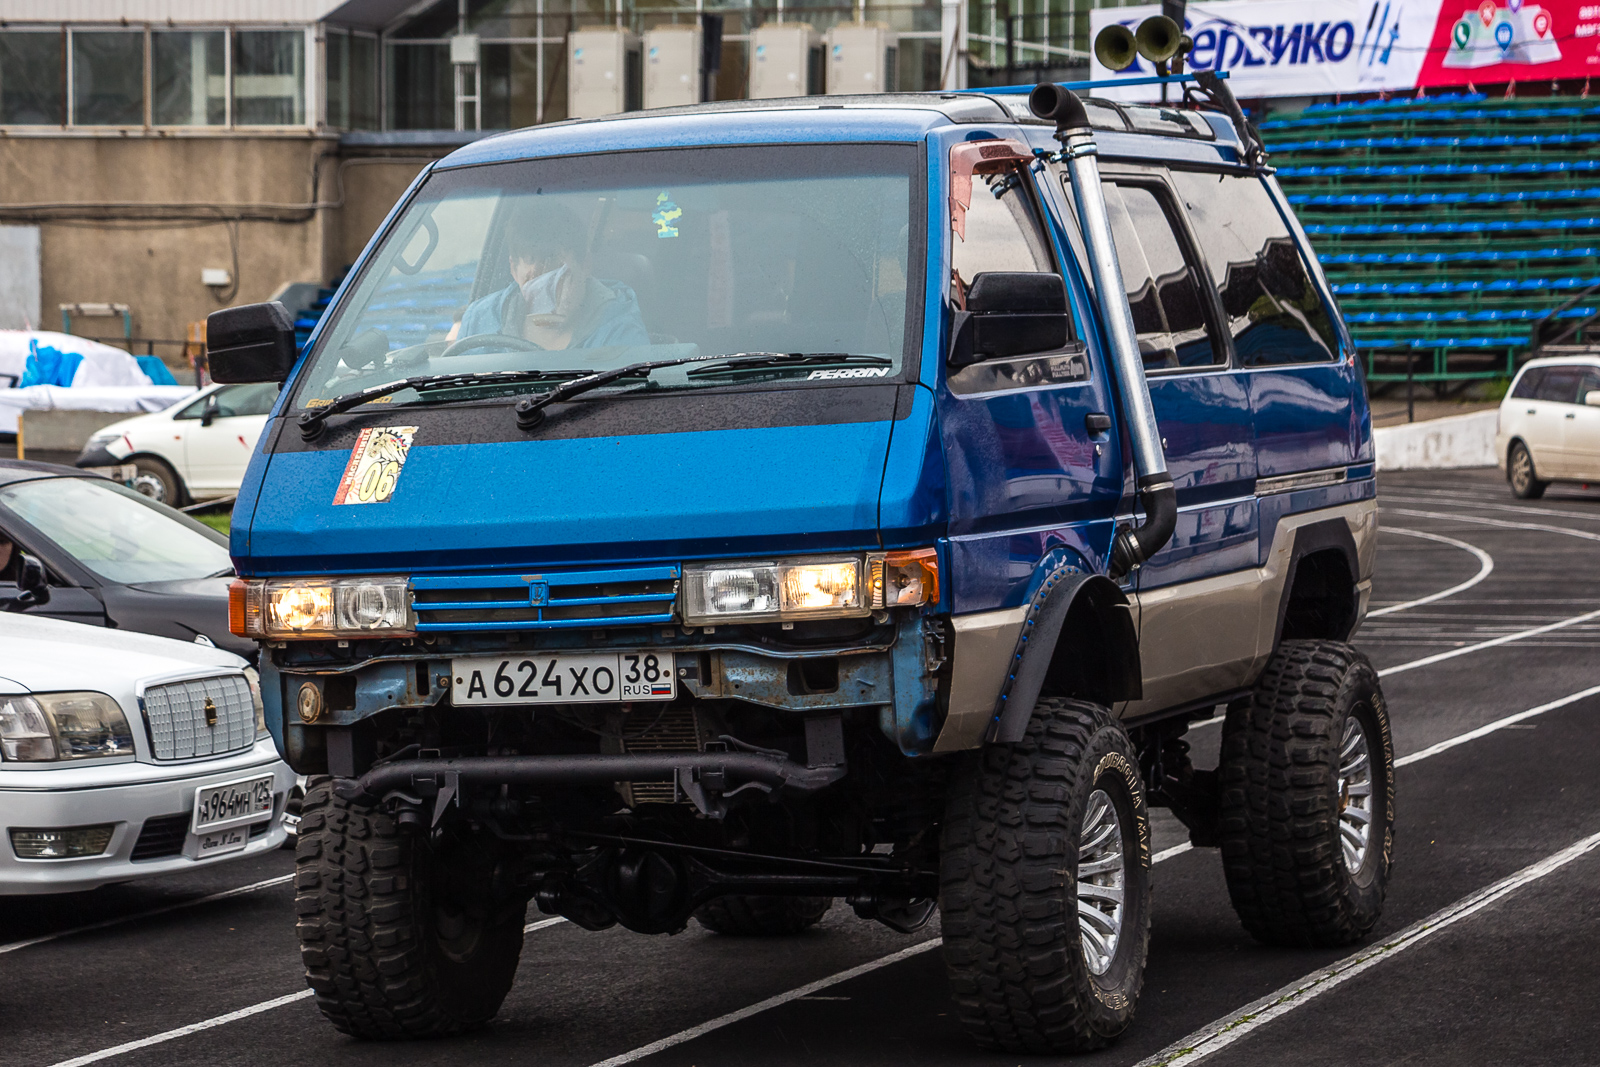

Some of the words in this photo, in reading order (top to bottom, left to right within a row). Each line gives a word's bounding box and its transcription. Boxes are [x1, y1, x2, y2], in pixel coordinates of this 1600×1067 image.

[1150, 17, 1355, 73] ервико
[807, 367, 890, 380] PERRIN
[359, 461, 399, 501] 06
[624, 655, 661, 683] 38
[623, 685, 650, 696] RUS
[252, 780, 270, 803] 125
